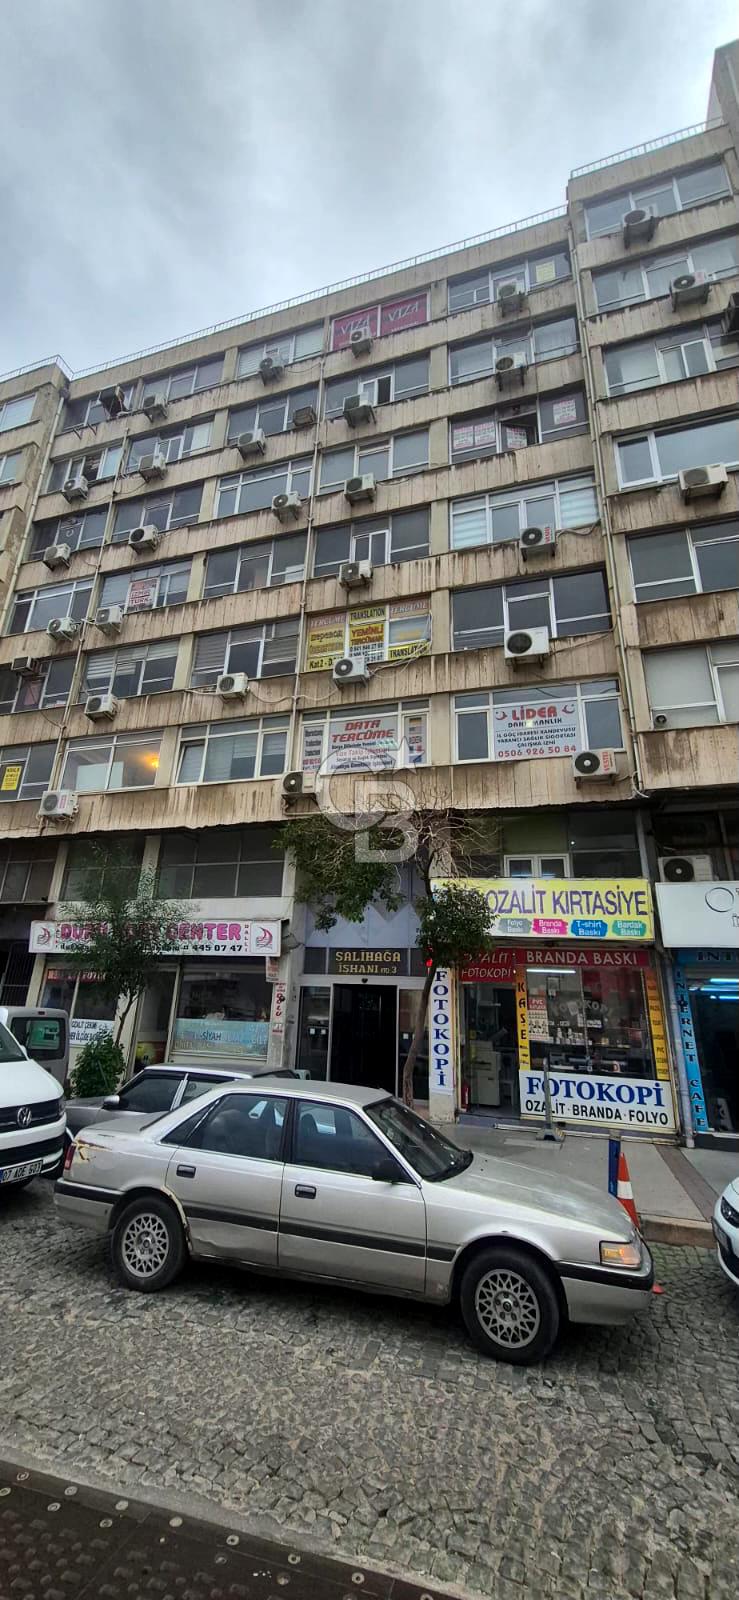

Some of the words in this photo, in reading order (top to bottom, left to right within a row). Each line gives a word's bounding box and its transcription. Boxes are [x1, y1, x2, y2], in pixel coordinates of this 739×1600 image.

[511, 704, 558, 720] LİDER
[345, 719, 381, 731] DATA
[508, 717, 563, 728] DANIMANLIK
[498, 749, 523, 758] 0506
[526, 747, 545, 756] 926
[564, 745, 577, 753] 84
[485, 884, 546, 914] OZALİT
[552, 885, 648, 916] KIRTASİYE
[538, 919, 562, 928] Branda
[576, 920, 602, 929] T-shirt
[617, 921, 644, 929] Bardak
[169, 922, 242, 942] CENTER
[192, 944, 212, 952] 445
[214, 944, 227, 952] 07
[230, 944, 243, 952] 47
[335, 949, 401, 962] SALİHAĞA
[526, 950, 588, 965] BRANDA
[593, 951, 638, 965] BASKI
[433, 970, 450, 1087] FOTOKOPİ
[526, 1076, 665, 1107] FOTOKOPİ
[572, 1104, 622, 1121] BRANDA
[628, 1109, 668, 1125] FOLYO
